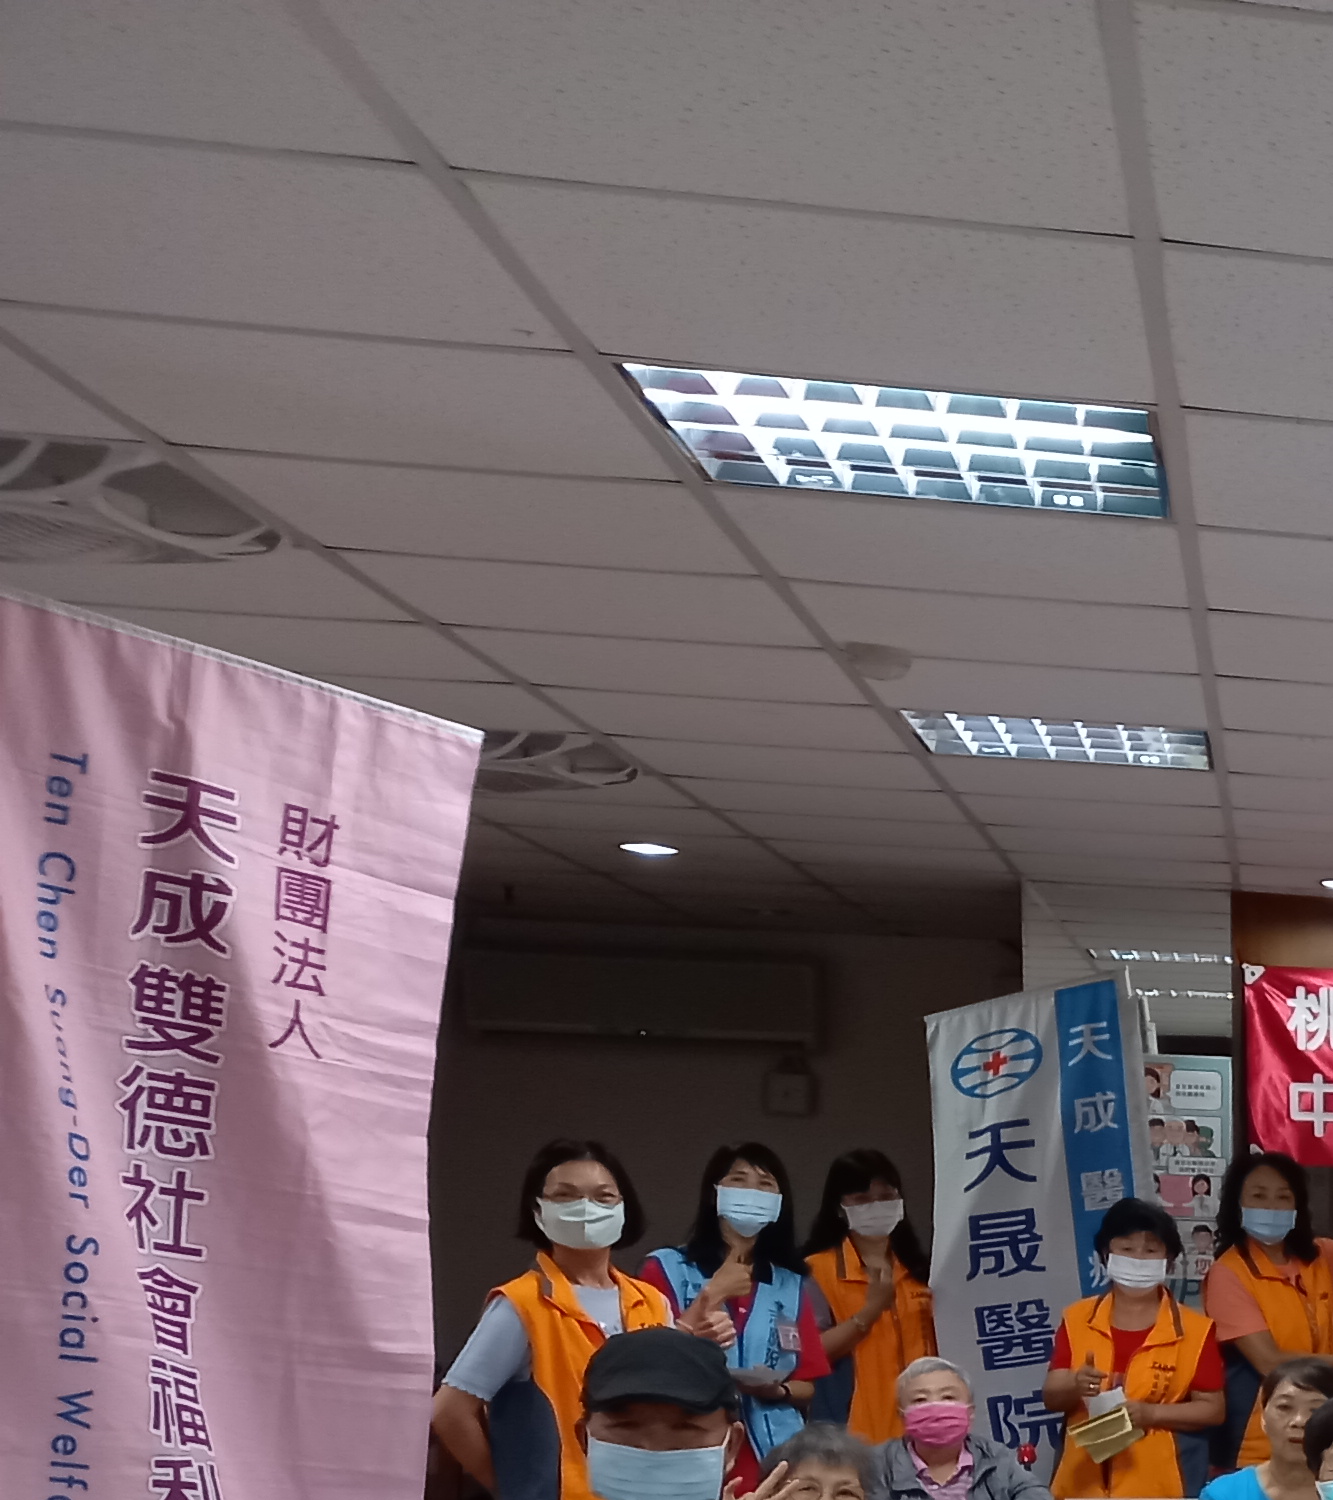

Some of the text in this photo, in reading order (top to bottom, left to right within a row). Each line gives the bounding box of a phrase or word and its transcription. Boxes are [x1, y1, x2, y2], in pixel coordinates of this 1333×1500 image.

[44, 752, 89, 826] Ten
[36, 851, 77, 960] Chen
[268, 802, 341, 1060] 財團法人
[58, 1234, 99, 1363] Social
[963, 1117, 1065, 1450] 天晟醫院
